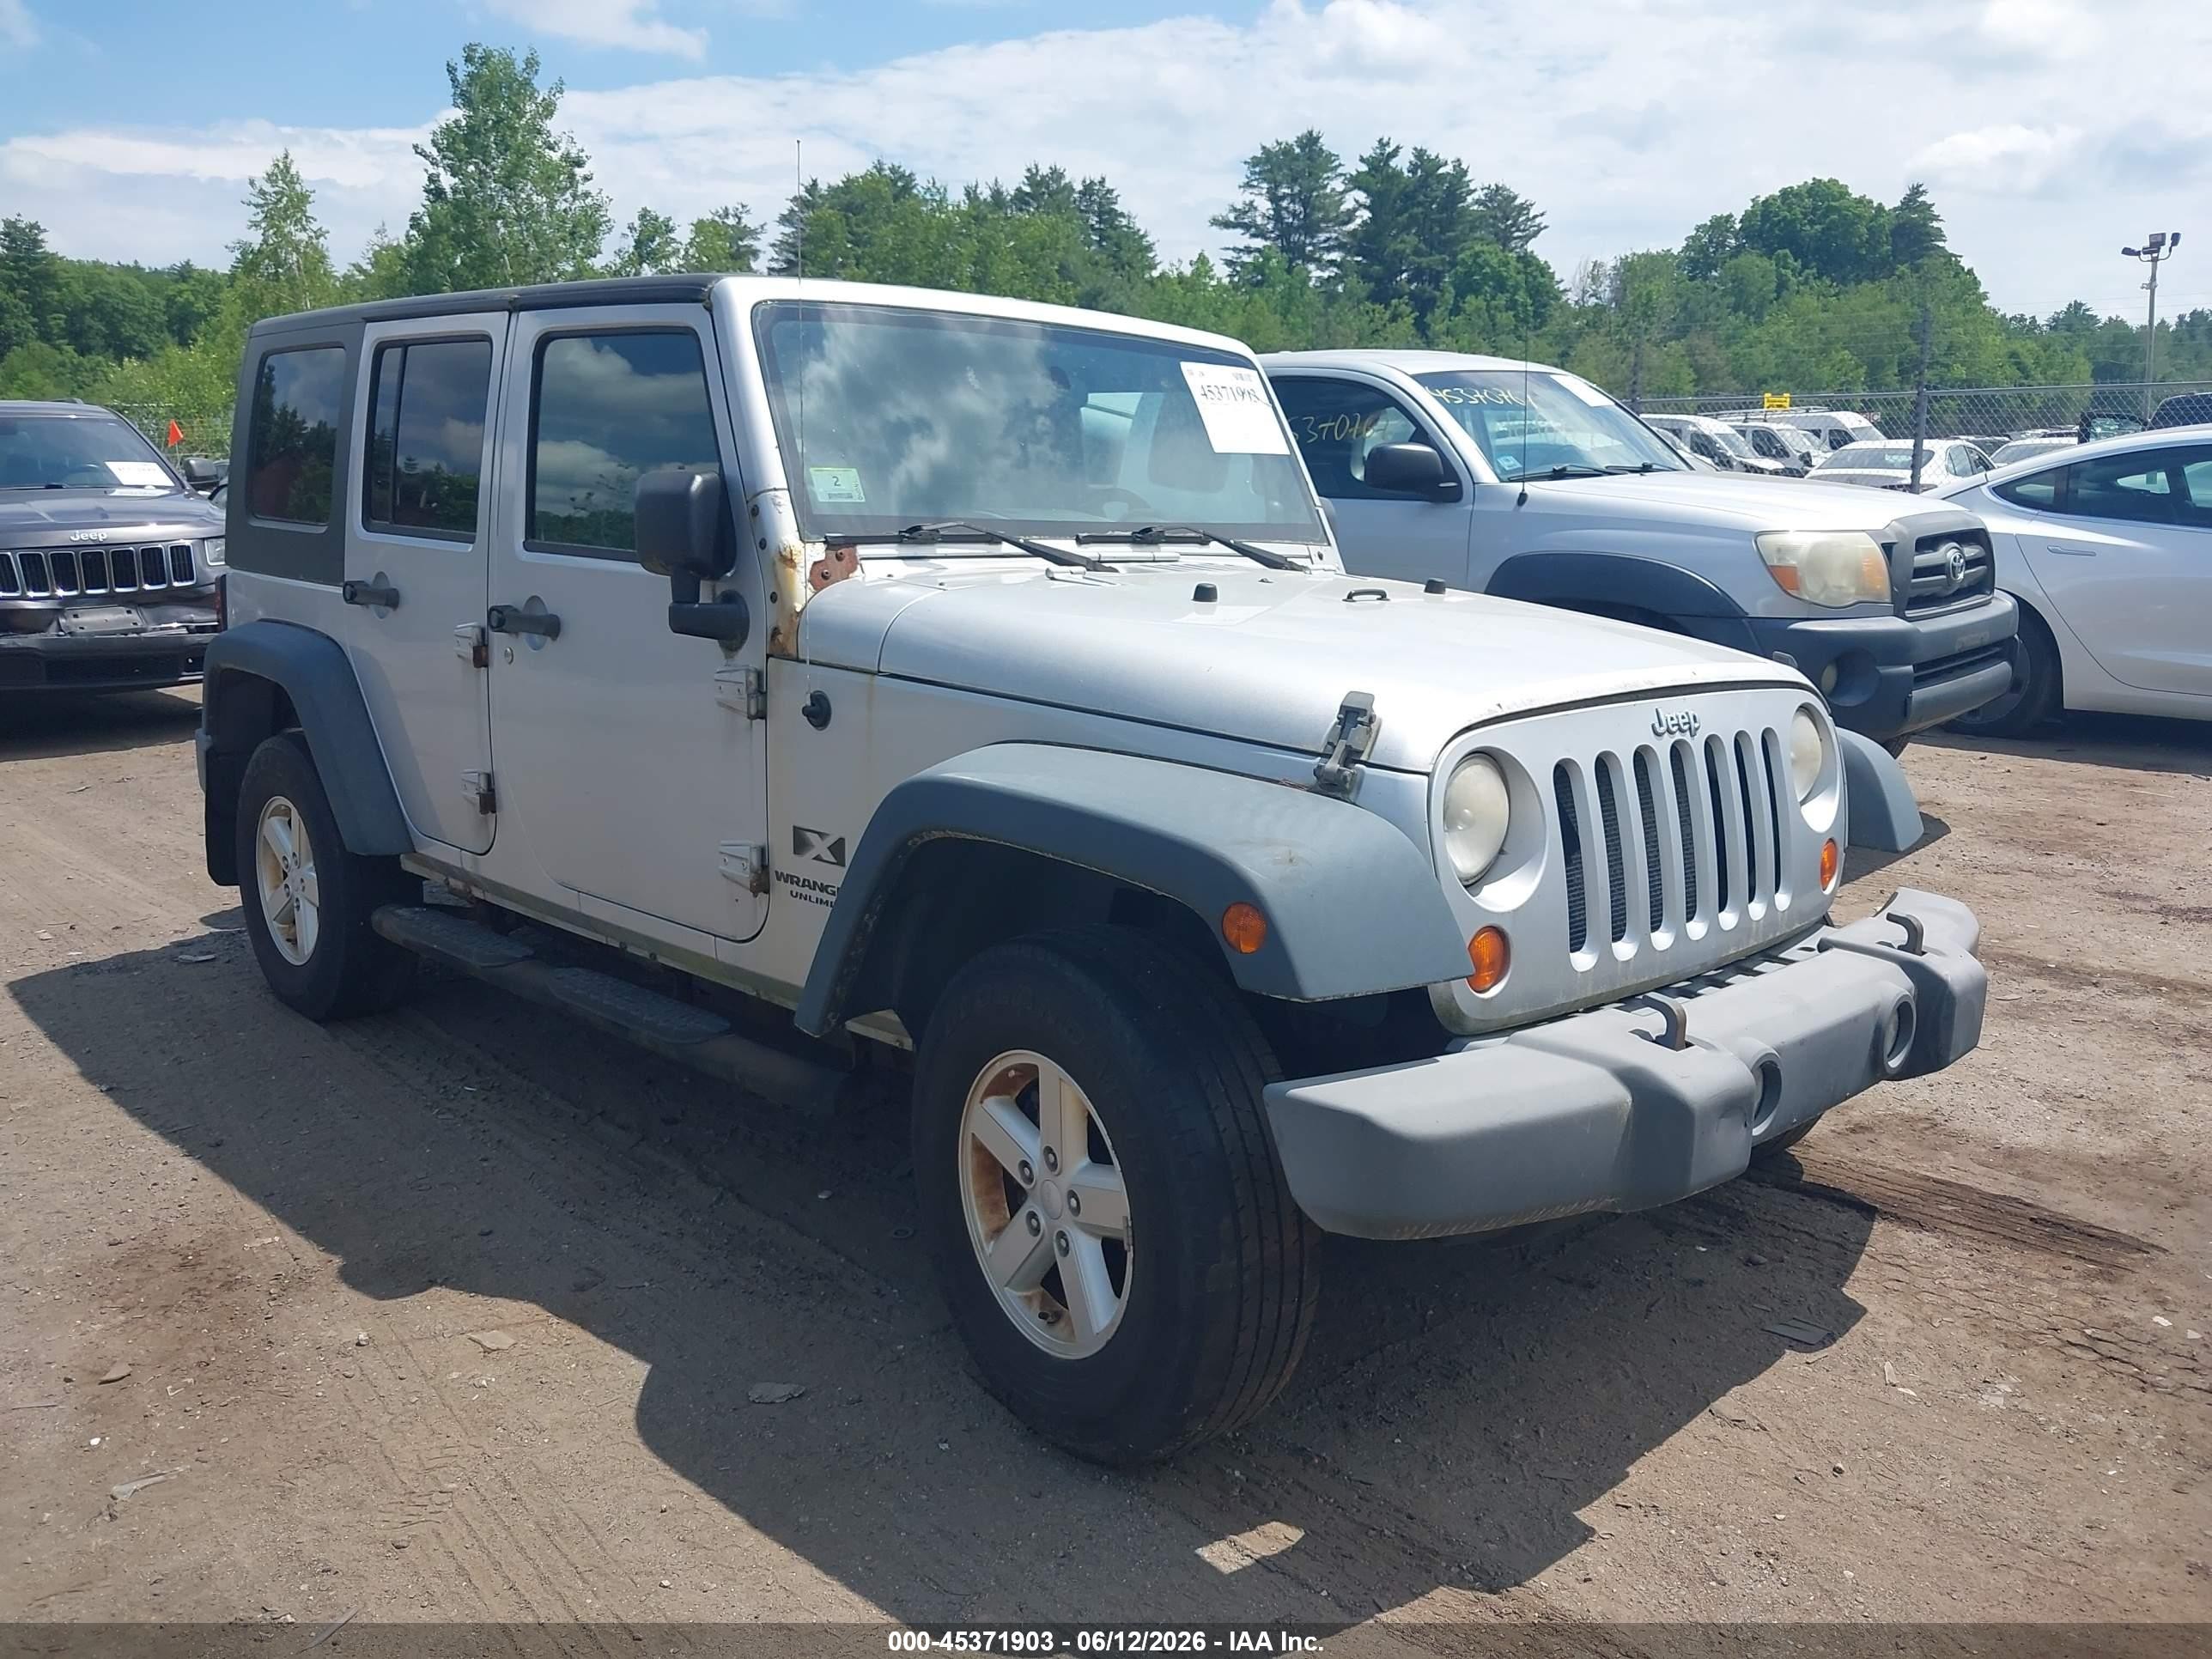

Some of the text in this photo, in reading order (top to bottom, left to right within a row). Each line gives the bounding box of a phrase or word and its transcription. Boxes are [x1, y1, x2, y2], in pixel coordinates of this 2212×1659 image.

[831, 475, 842, 487] 2
[70, 530, 108, 542] Jeep
[1650, 706, 1701, 738] Jeep
[775, 870, 840, 897] WRANG
